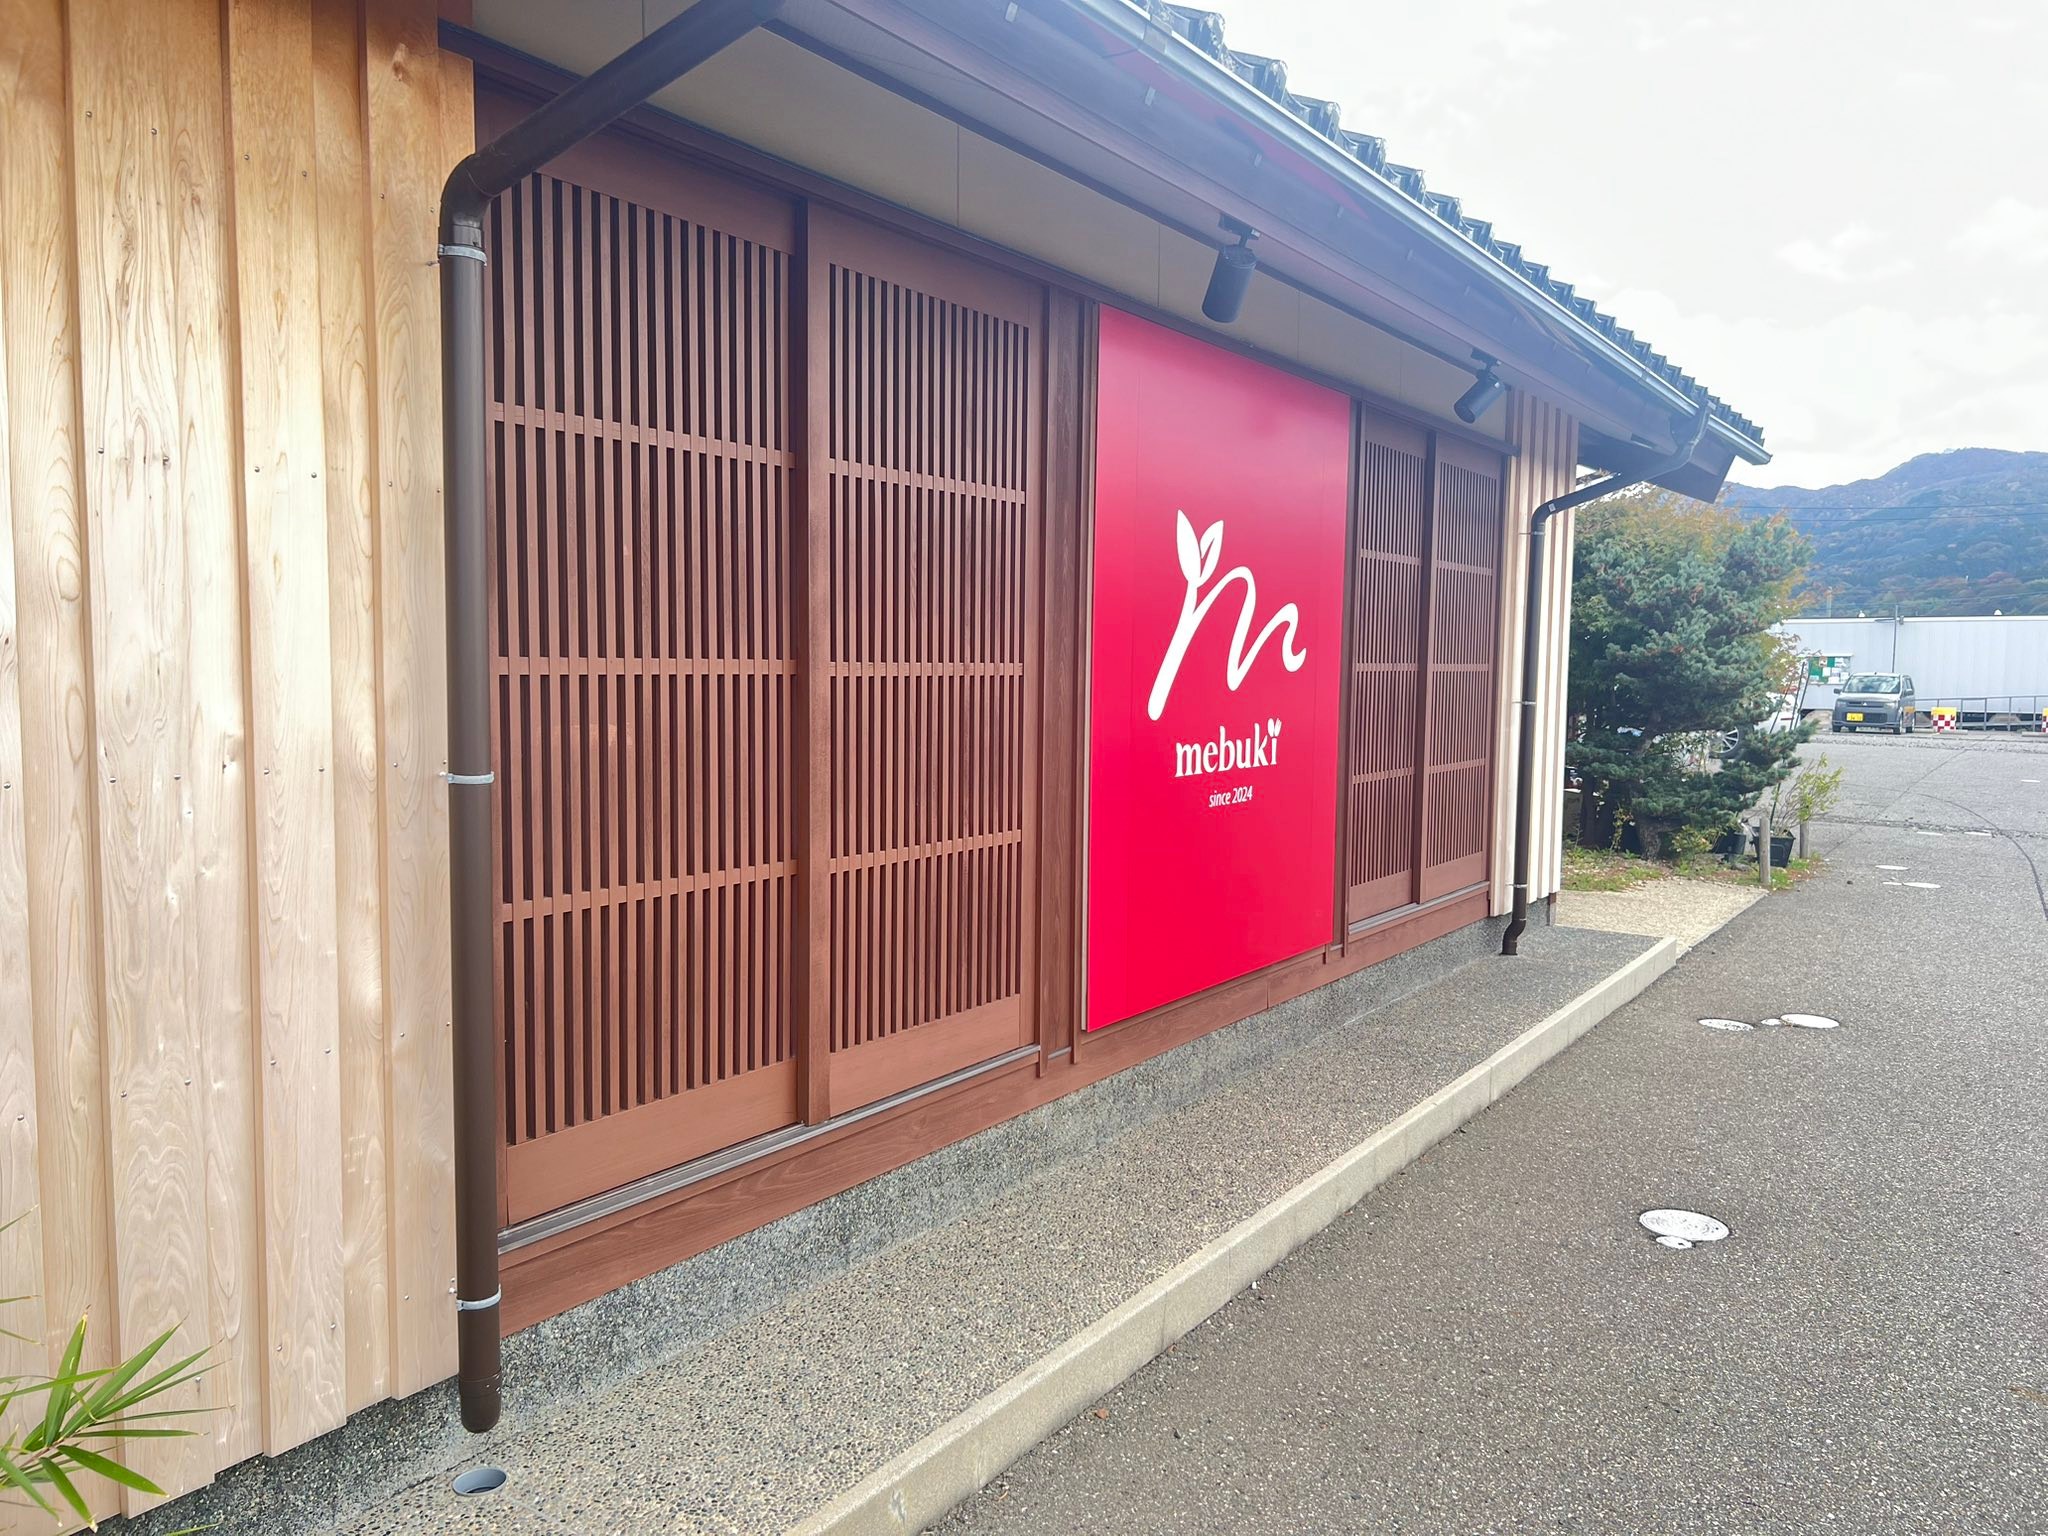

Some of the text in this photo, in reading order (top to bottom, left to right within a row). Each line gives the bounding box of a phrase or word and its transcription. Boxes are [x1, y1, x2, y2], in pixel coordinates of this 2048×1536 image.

[1174, 717, 1282, 778] mebuki
[1208, 785, 1253, 808] since 2024
